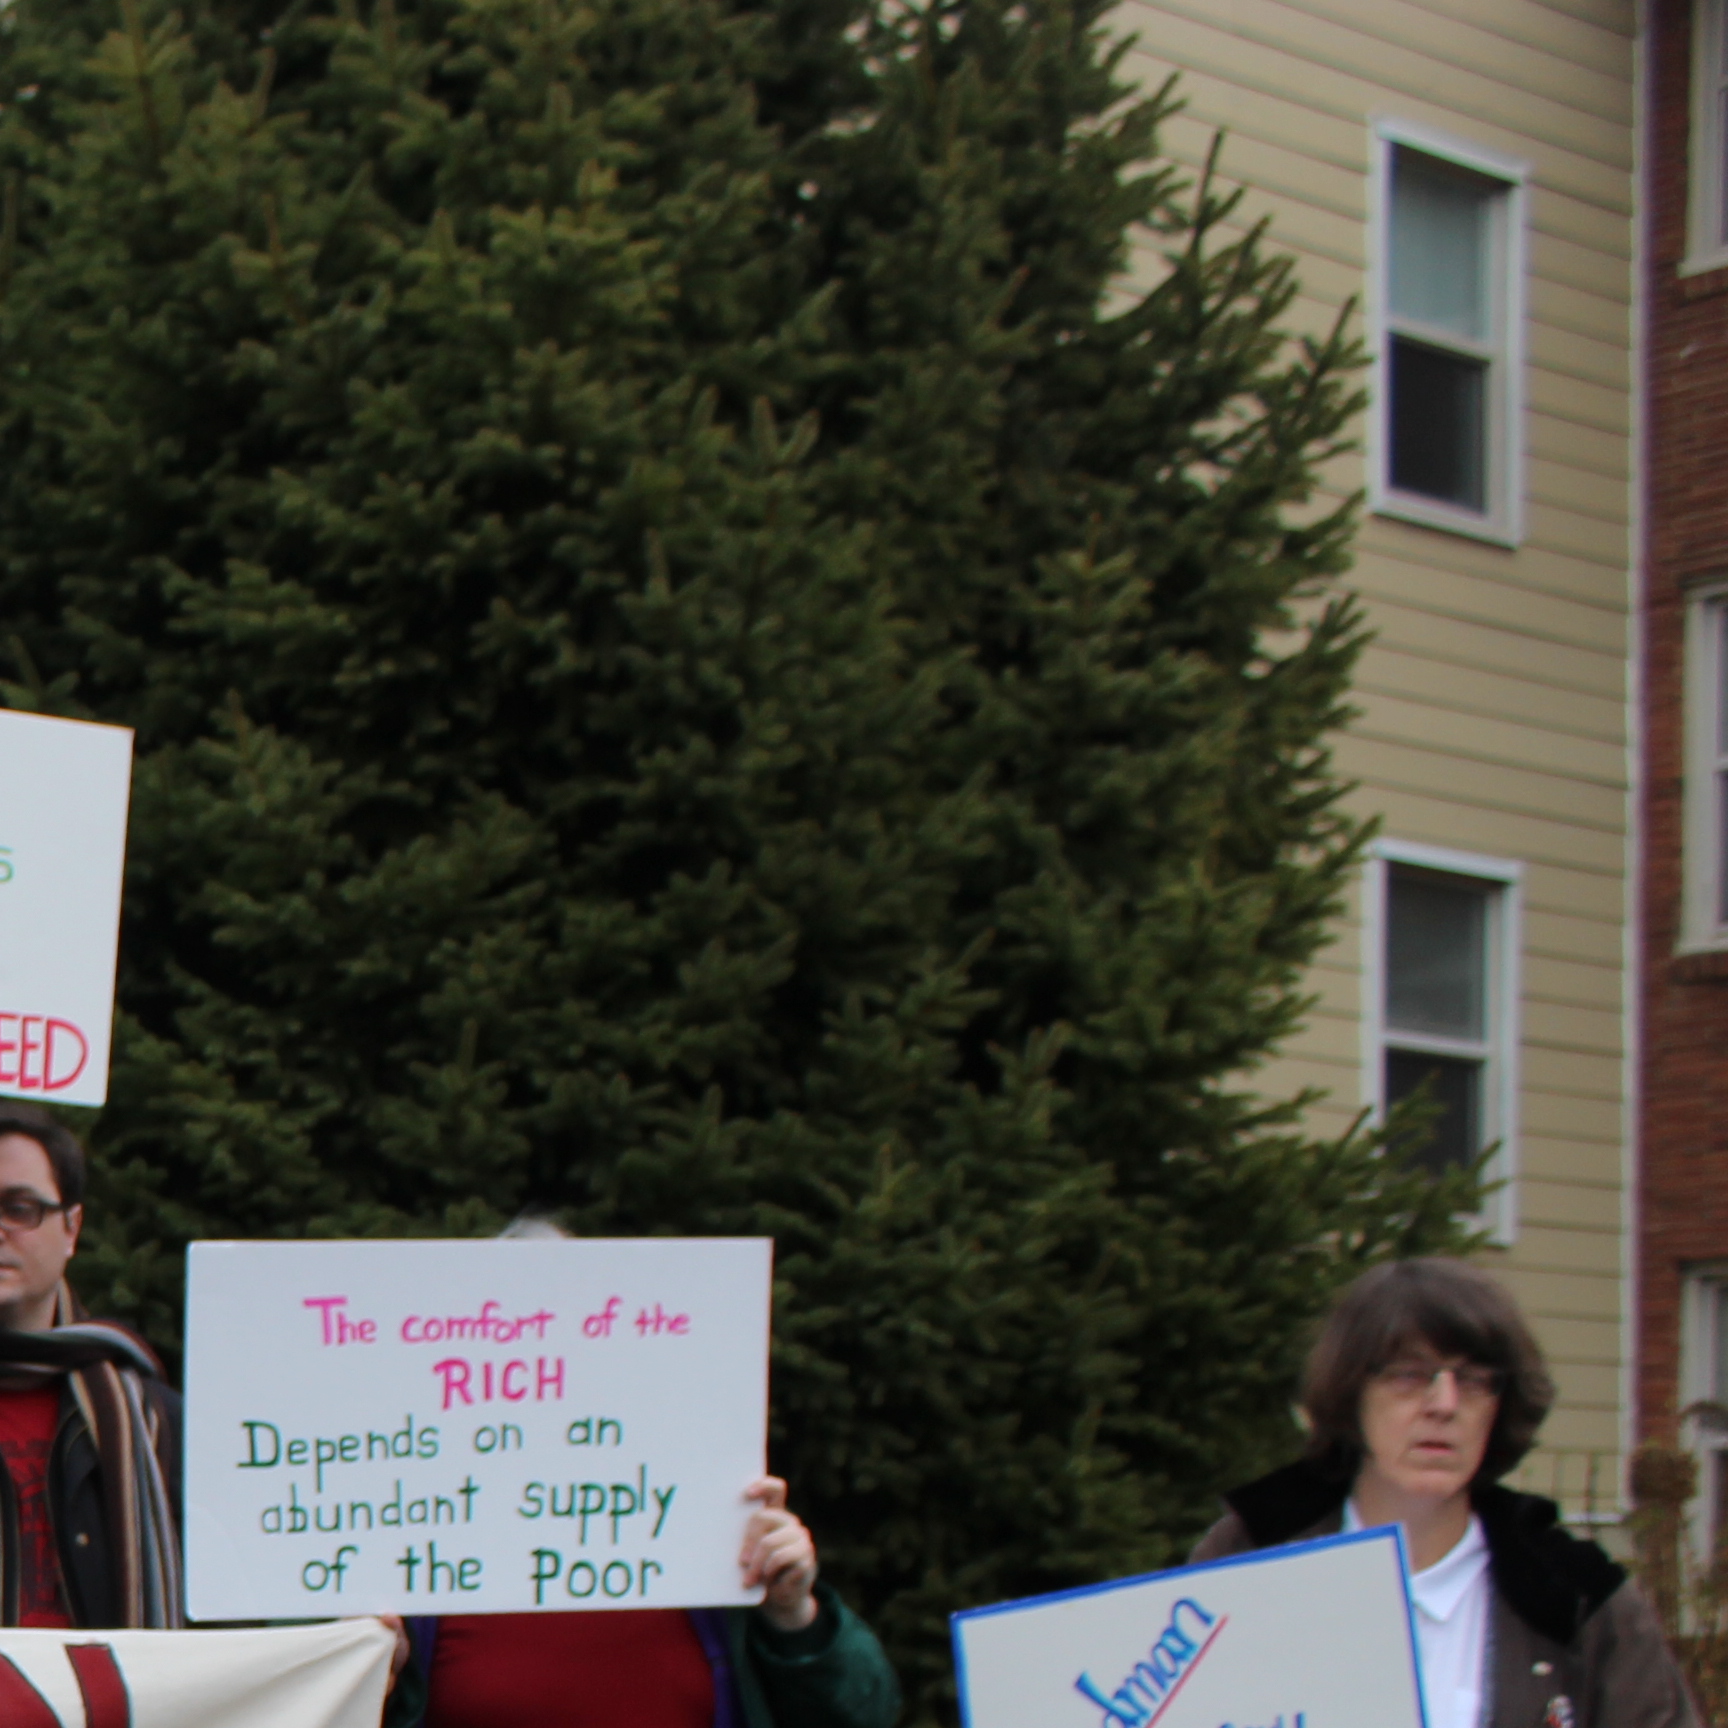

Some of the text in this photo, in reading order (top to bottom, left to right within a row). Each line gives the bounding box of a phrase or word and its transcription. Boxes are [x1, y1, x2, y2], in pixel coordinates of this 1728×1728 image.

[304, 1296, 691, 1346] The comfort of the
[433, 1357, 565, 1410] RICH
[237, 1414, 623, 1492] Depends on an
[261, 1464, 675, 1544] abundant supply
[302, 1546, 358, 1593] of
[397, 1540, 483, 1593] the
